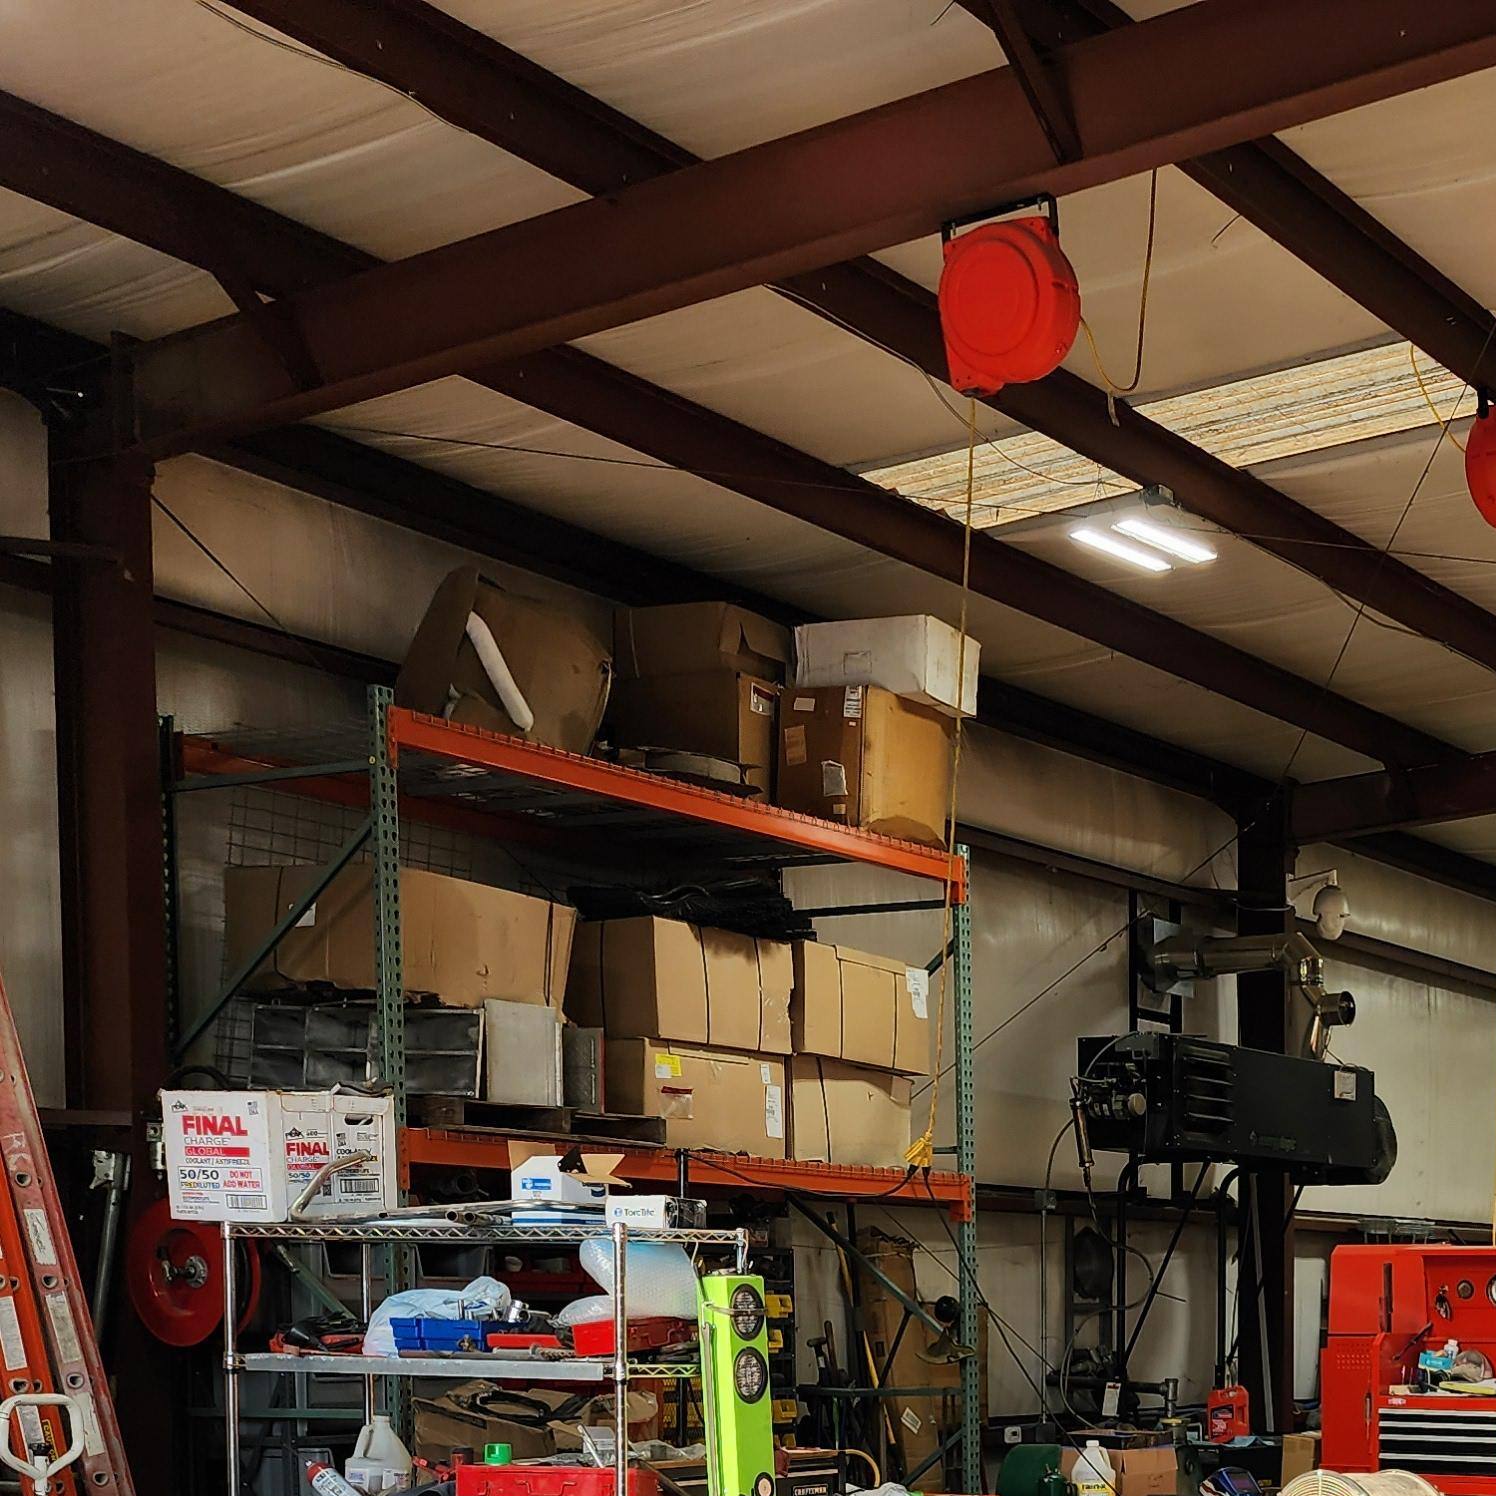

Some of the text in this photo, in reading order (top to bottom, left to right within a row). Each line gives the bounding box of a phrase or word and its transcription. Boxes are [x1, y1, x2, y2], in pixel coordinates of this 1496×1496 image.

[182, 1115, 248, 1136] FINAL
[184, 1137, 229, 1145] CHARGE
[185, 1147, 226, 1156] GLOBAL
[285, 1142, 329, 1156] FINAL
[186, 1157, 211, 1165] COOLANT
[180, 1168, 219, 1180] 50/50
[229, 1170, 252, 1179] DO NOT
[239, 1180, 260, 1188] WATER
